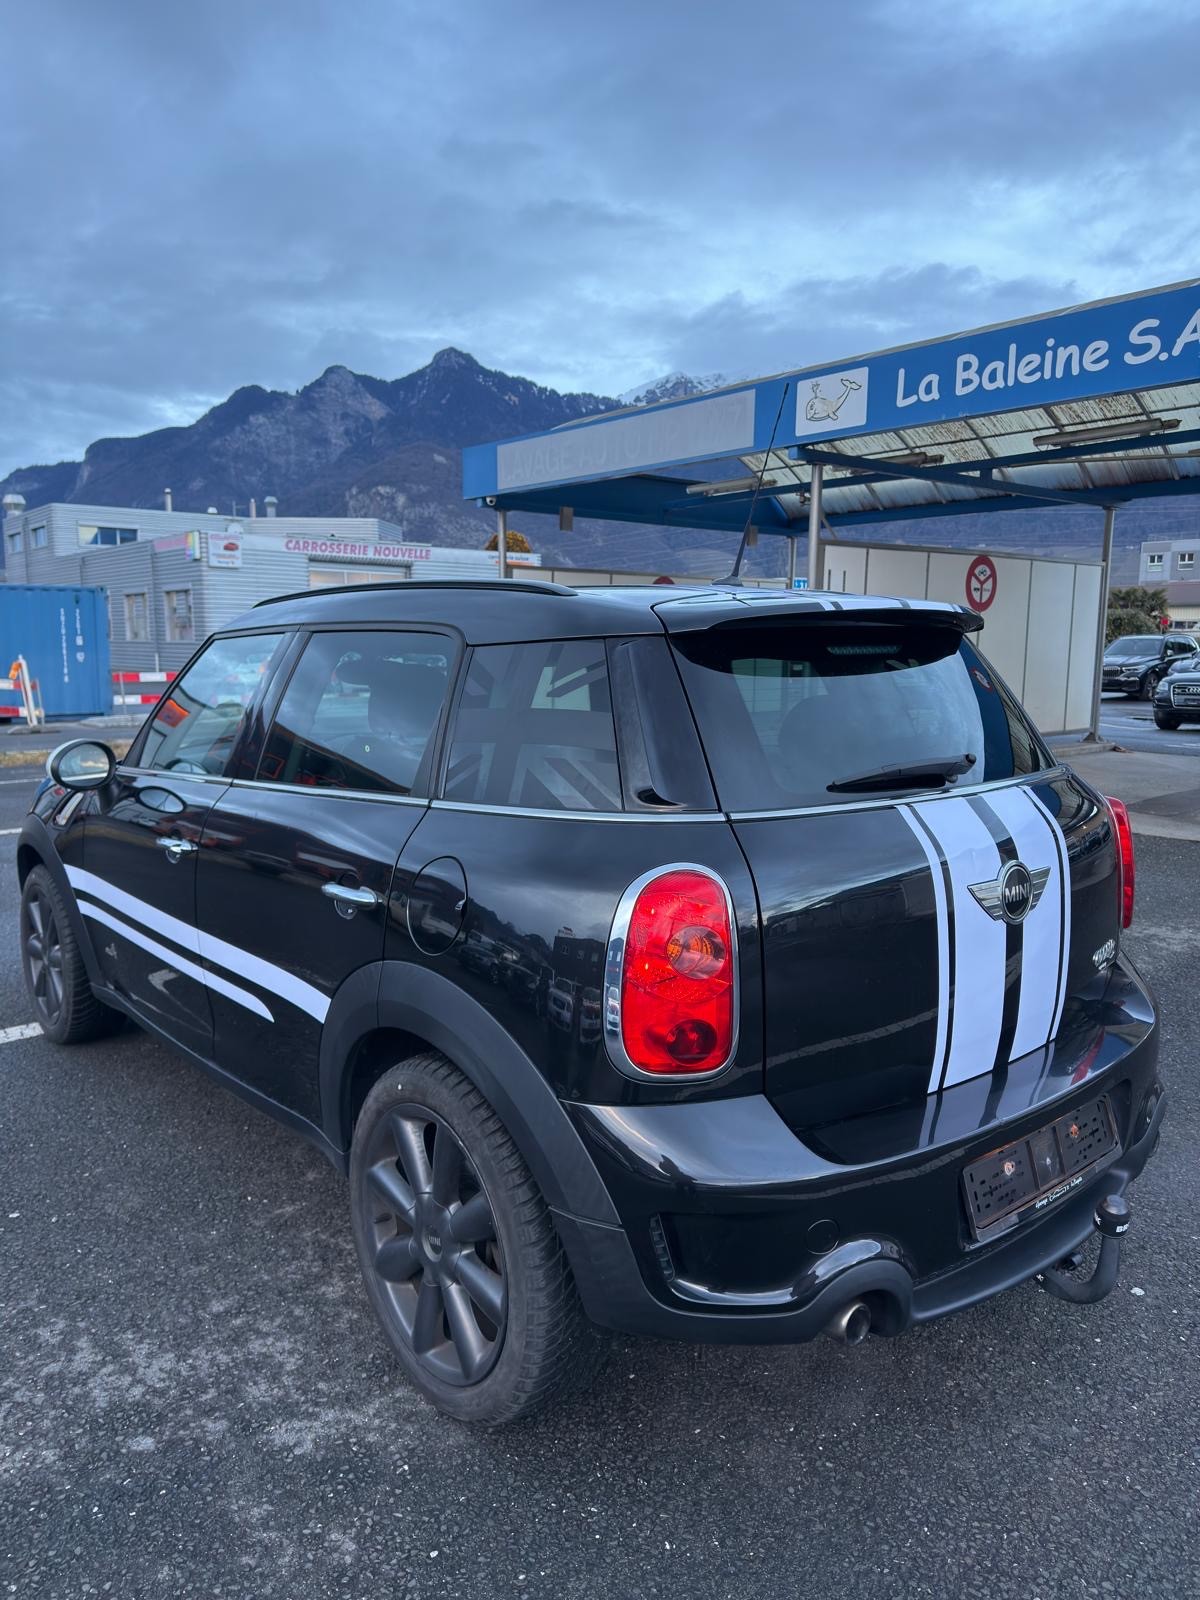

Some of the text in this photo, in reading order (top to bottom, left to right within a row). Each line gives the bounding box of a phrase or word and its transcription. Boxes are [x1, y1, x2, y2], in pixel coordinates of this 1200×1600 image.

[896, 368, 940, 408] La
[955, 338, 1109, 396] Baleine
[285, 539, 431, 560] CARROSSERIE NOUVELLE
[1004, 882, 1030, 904] MINI
